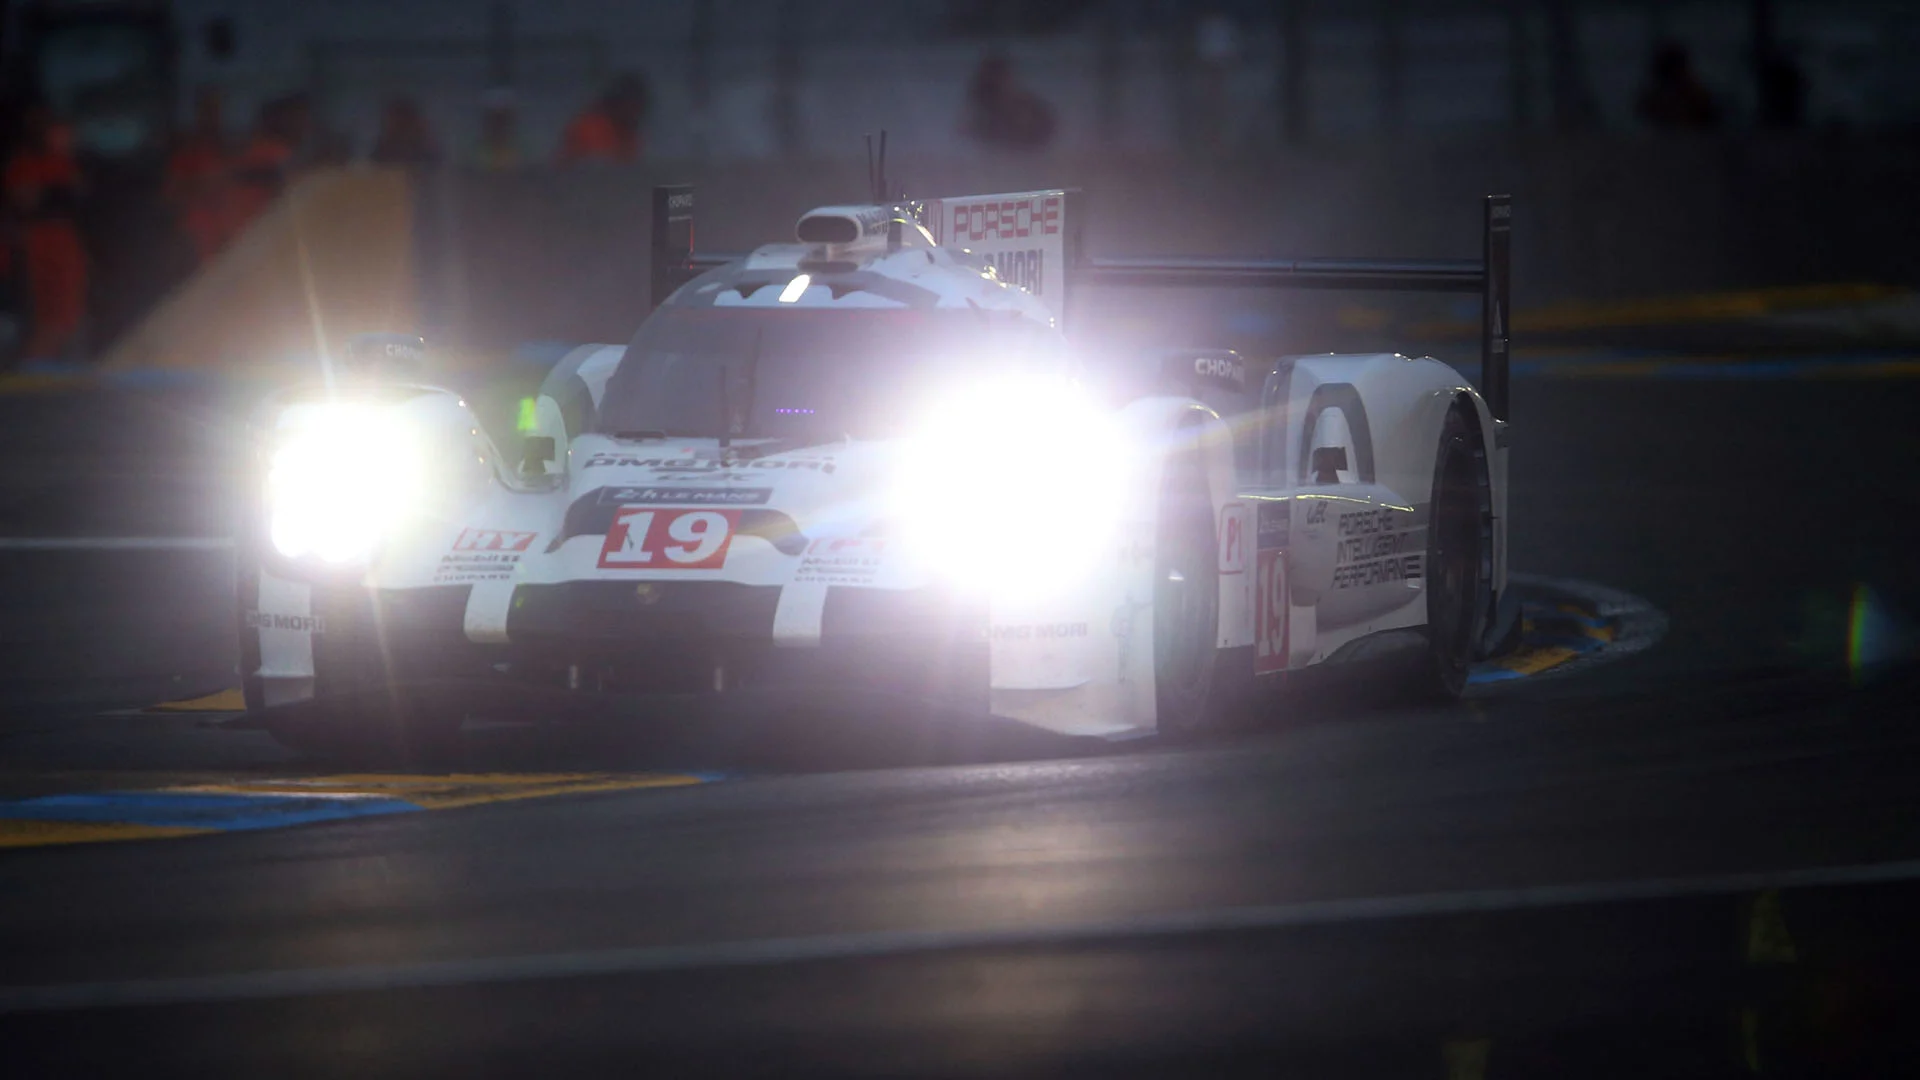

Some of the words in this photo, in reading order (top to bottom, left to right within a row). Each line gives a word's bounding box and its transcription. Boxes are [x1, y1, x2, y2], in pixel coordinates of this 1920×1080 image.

[953, 198, 1059, 243] PORSCHE
[694, 491, 759, 501] MANS
[605, 510, 730, 564] 19
[1338, 509, 1393, 536] PORSCHE
[1336, 532, 1408, 564] INTELLIGENT
[1330, 555, 1421, 589] PERFORMANCE
[275, 614, 324, 631] MORI
[1257, 556, 1287, 657] 19
[1035, 622, 1088, 640] MORI
